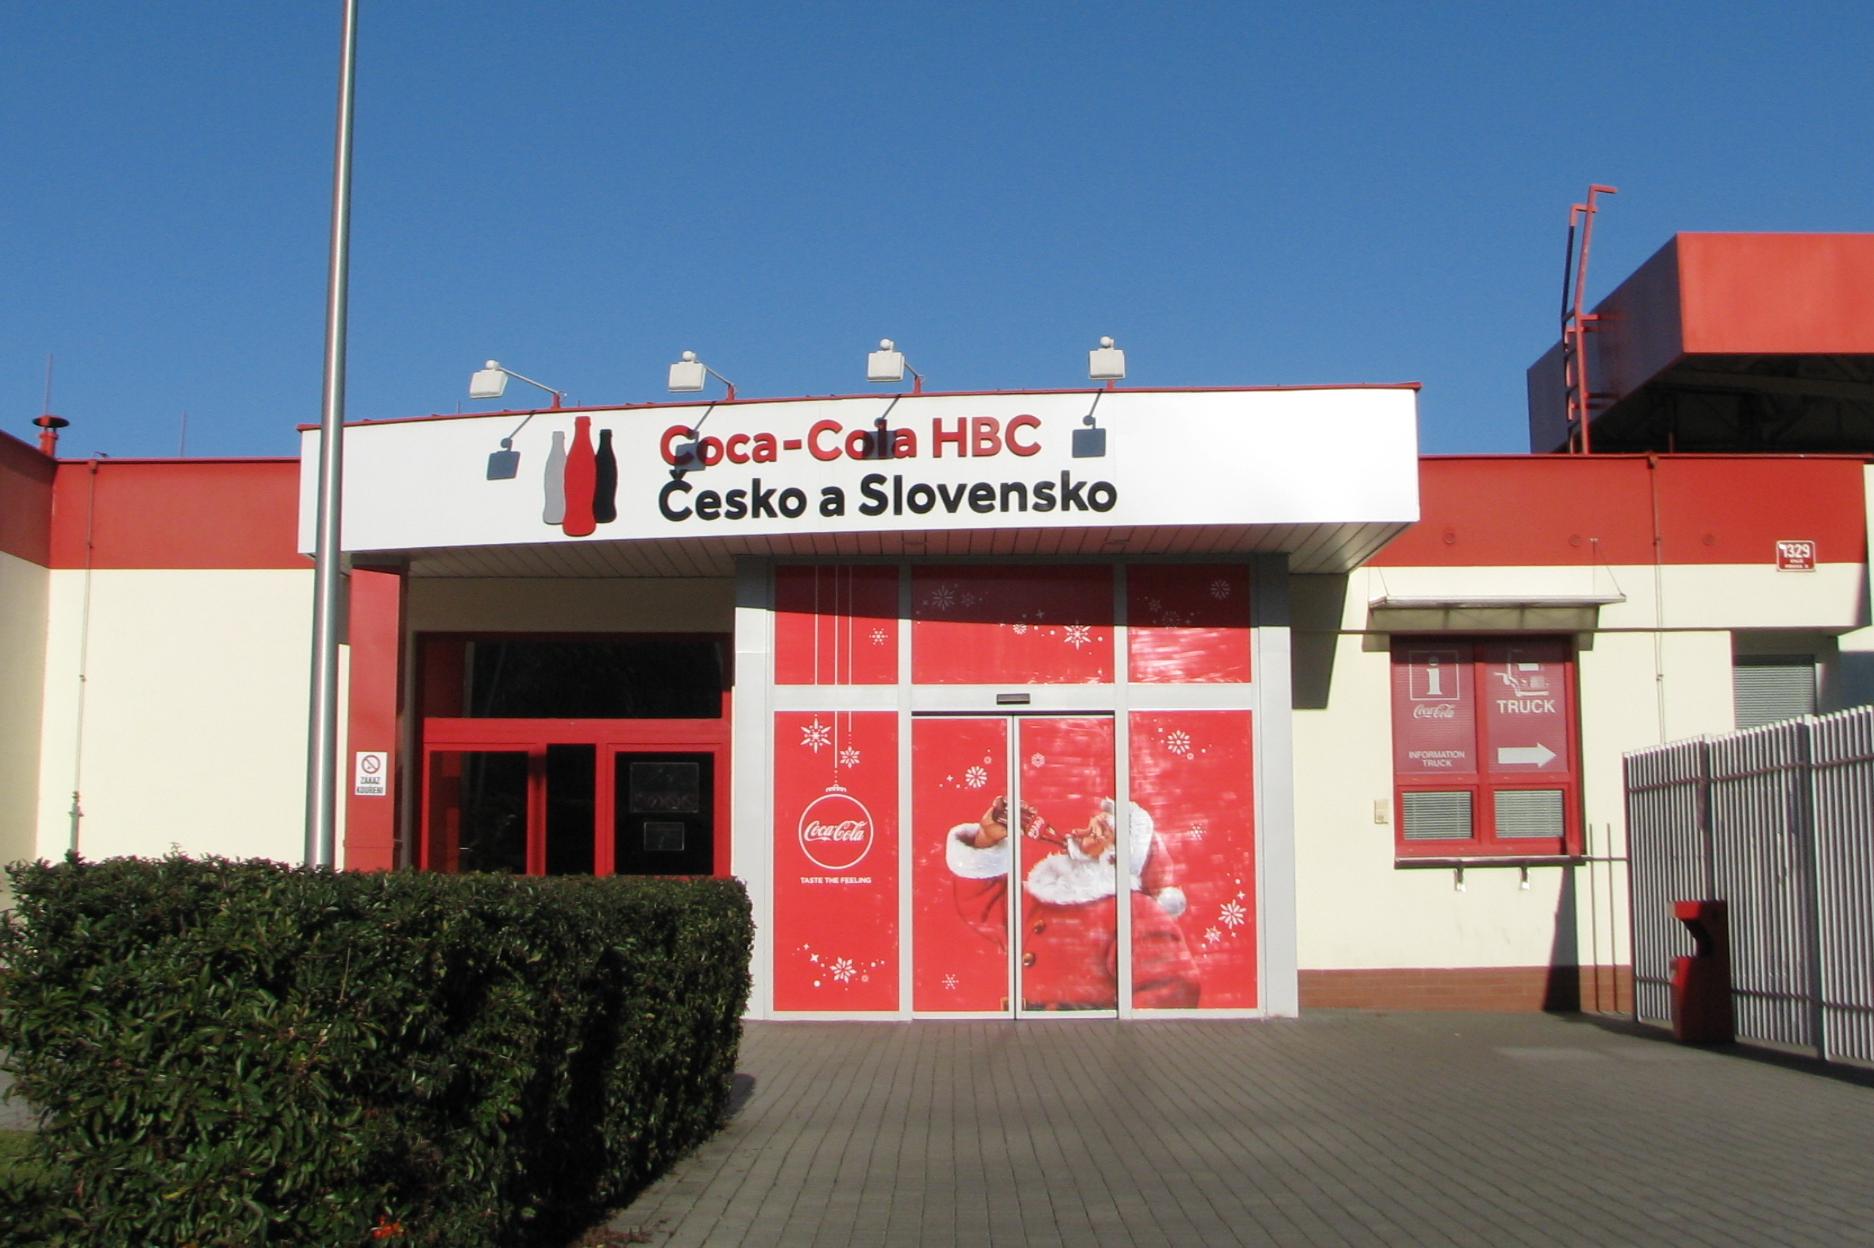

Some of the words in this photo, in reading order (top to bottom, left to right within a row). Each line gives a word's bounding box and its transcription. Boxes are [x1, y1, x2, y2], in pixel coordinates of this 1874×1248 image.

[660, 418, 917, 466] Coca-Cola
[932, 414, 1042, 459] HBC
[658, 470, 807, 522] Česko
[820, 487, 845, 517] a
[859, 470, 1118, 517] Slovensko
[1779, 543, 1811, 558] 1329
[1496, 699, 1556, 714] TRUCK
[1408, 750, 1465, 759] INFORMATION
[1422, 759, 1453, 767] TRUCK
